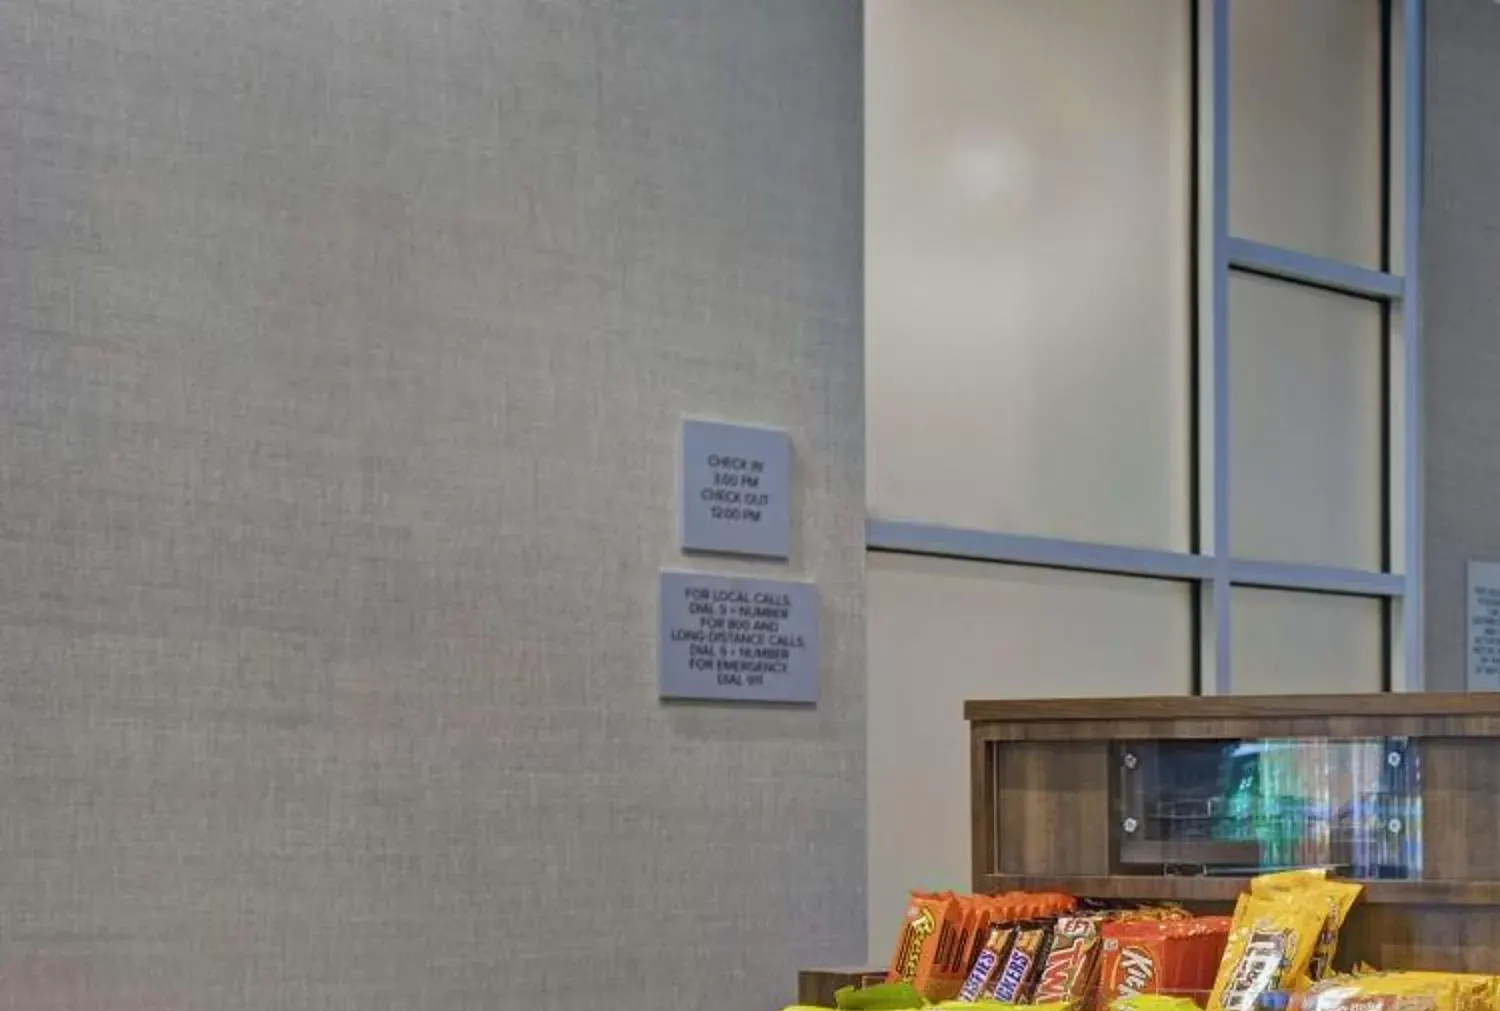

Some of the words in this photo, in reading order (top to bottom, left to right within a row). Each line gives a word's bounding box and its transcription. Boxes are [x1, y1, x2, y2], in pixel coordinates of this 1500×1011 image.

[707, 454, 747, 472] CHECK
[740, 474, 760, 489] PM
[700, 488, 740, 504] CHECK
[744, 493, 770, 507] OUT
[710, 505, 741, 521] 12:00
[742, 508, 762, 522] PM
[684, 588, 710, 601] FOR
[739, 606, 789, 619] NUMBER
[700, 616, 725, 628] FOR
[752, 620, 779, 633] AND
[671, 628, 706, 642] LONG
[709, 631, 765, 646] DISTANCE
[739, 648, 790, 660] NUMBER
[689, 658, 714, 671] FOR
[716, 660, 788, 673] EMERGENCY
